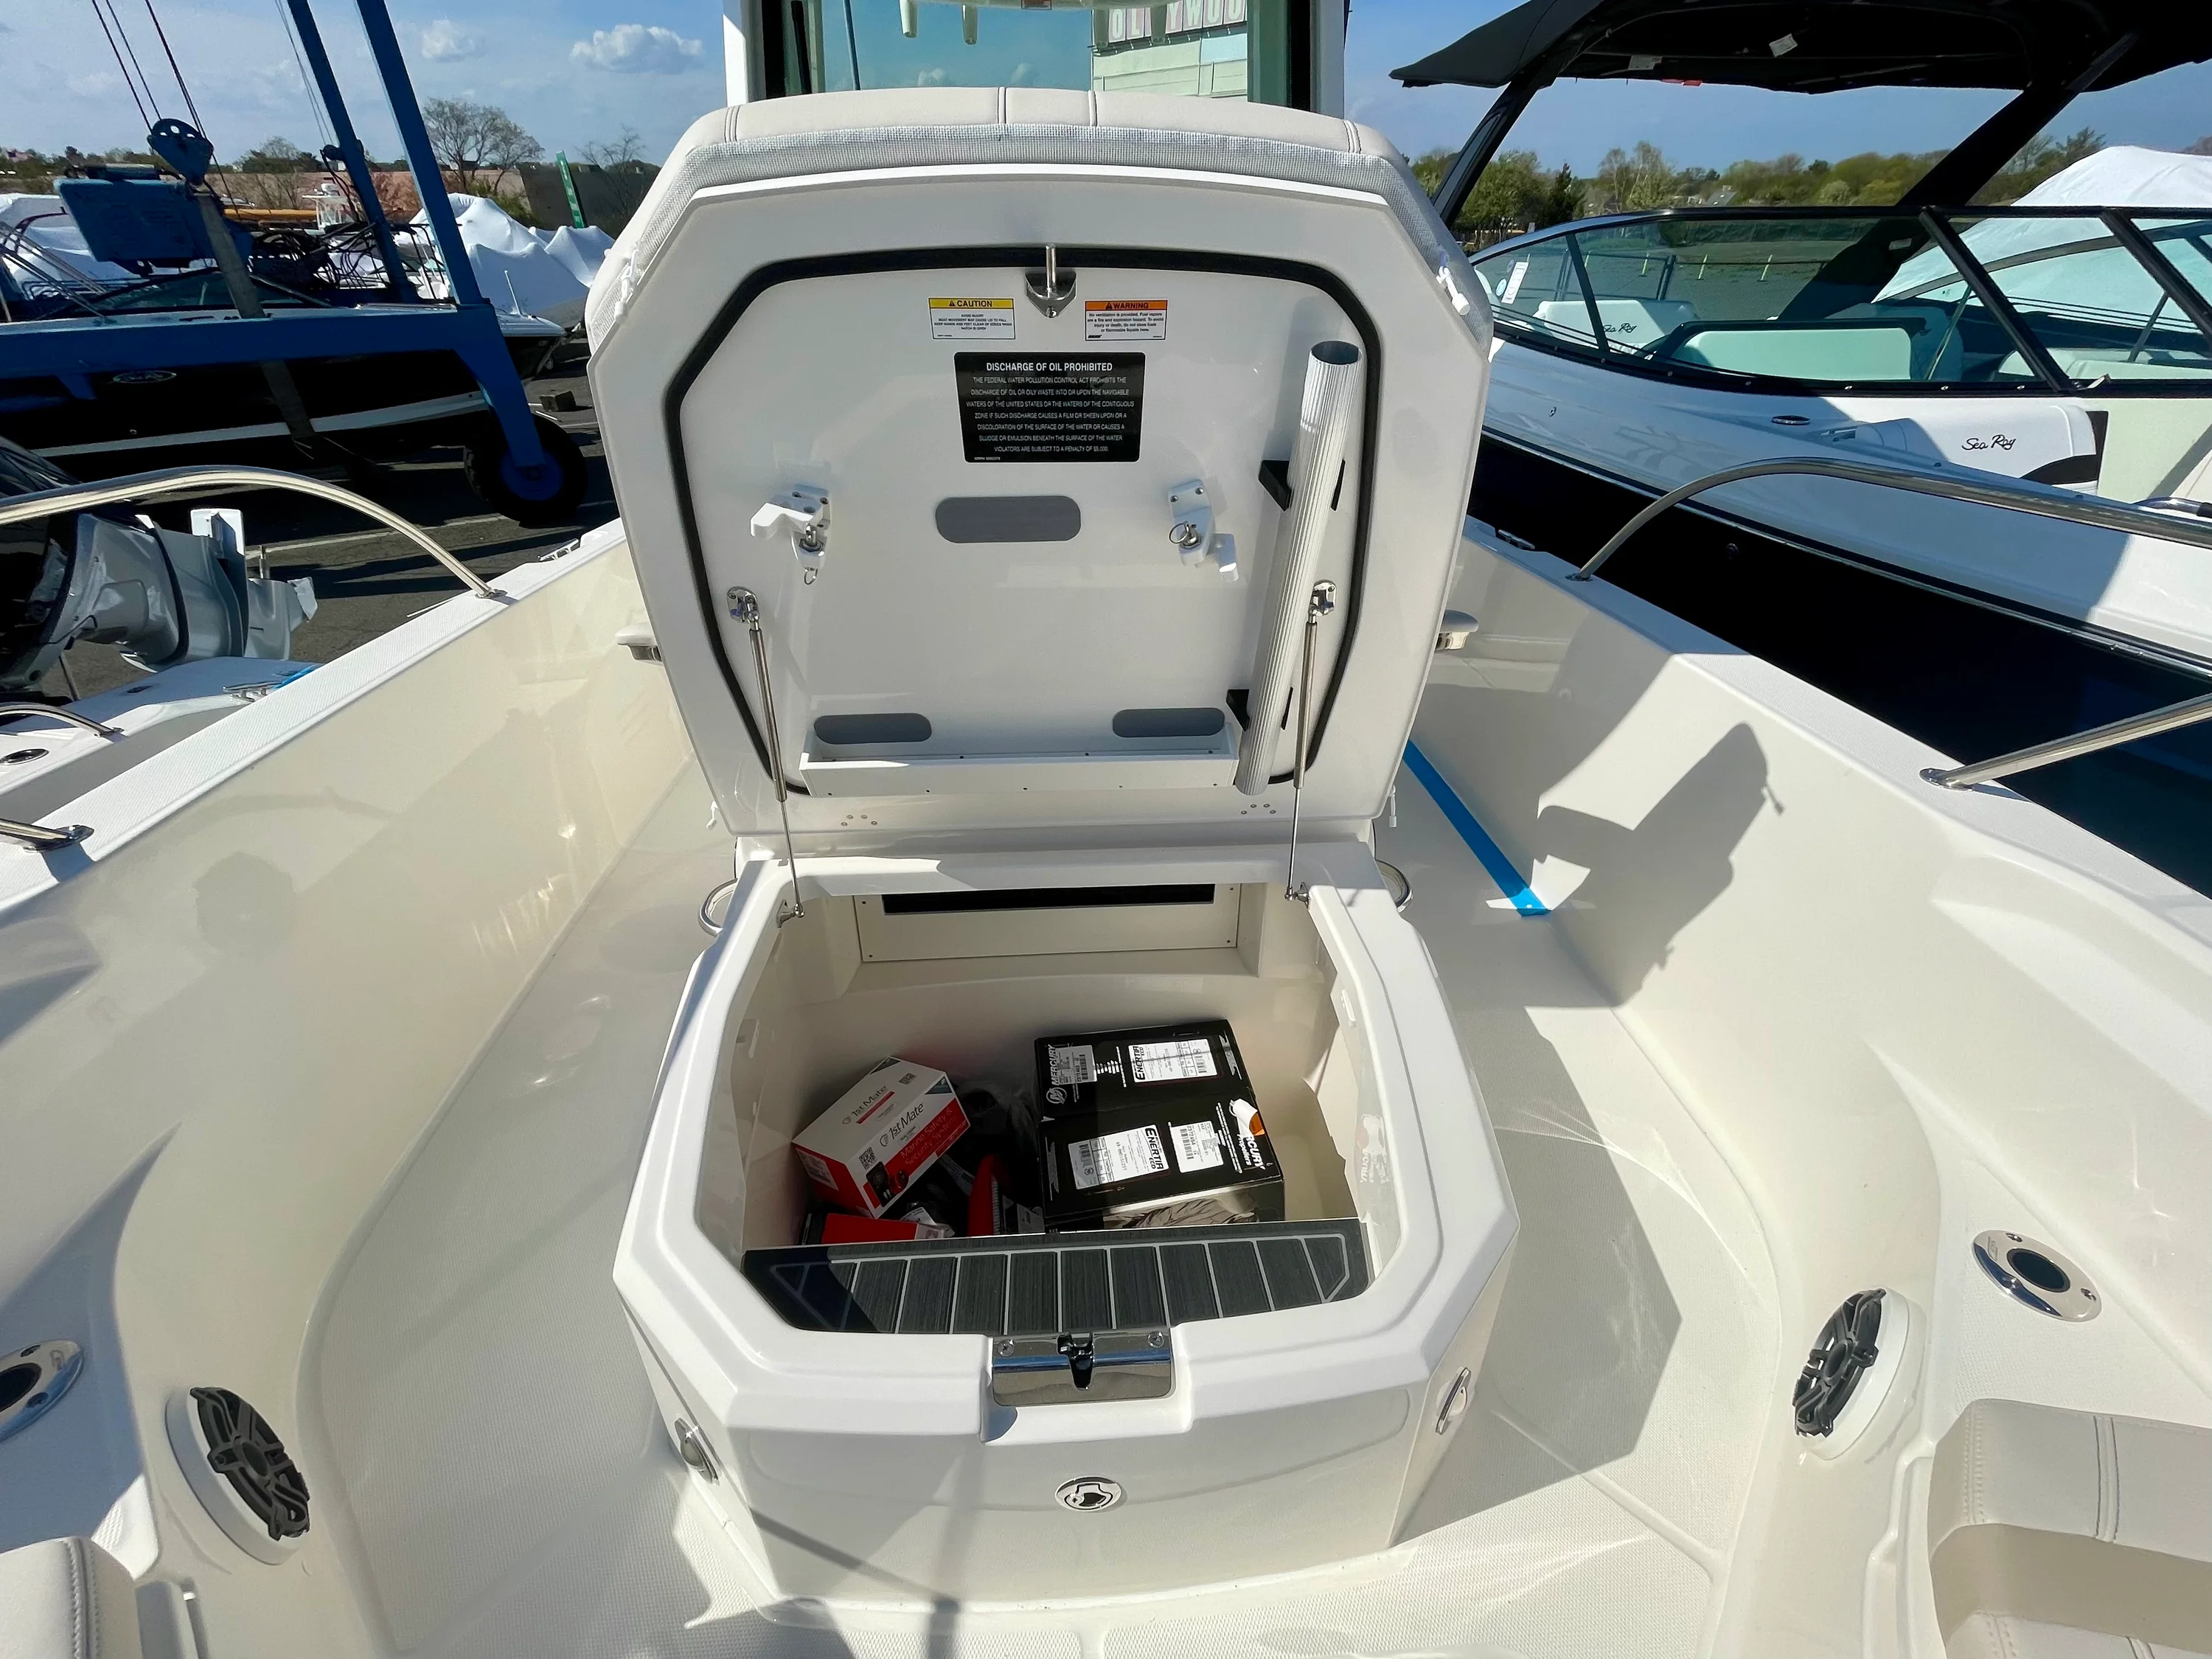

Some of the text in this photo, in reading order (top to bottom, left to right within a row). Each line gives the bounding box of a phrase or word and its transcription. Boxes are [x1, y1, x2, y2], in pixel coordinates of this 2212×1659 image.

[1618, 322, 1638, 333] Ray
[987, 363, 1112, 371] DISCHARGE OF OIL PROHIBITED
[1961, 434, 2017, 451] Sea Ray
[1048, 1044, 1060, 1085] MERCURY
[1133, 1046, 1145, 1080] ENERTIA
[851, 1105, 864, 1116] 1st
[863, 1086, 886, 1107] Mate
[889, 1123, 902, 1139] 1st
[900, 1103, 924, 1128] Mate
[900, 1107, 953, 1158] Marine Safety &
[905, 1116, 956, 1165] Security System
[1145, 1128, 1164, 1169] ENERTIA
[1237, 1134, 1252, 1165] Propellers
